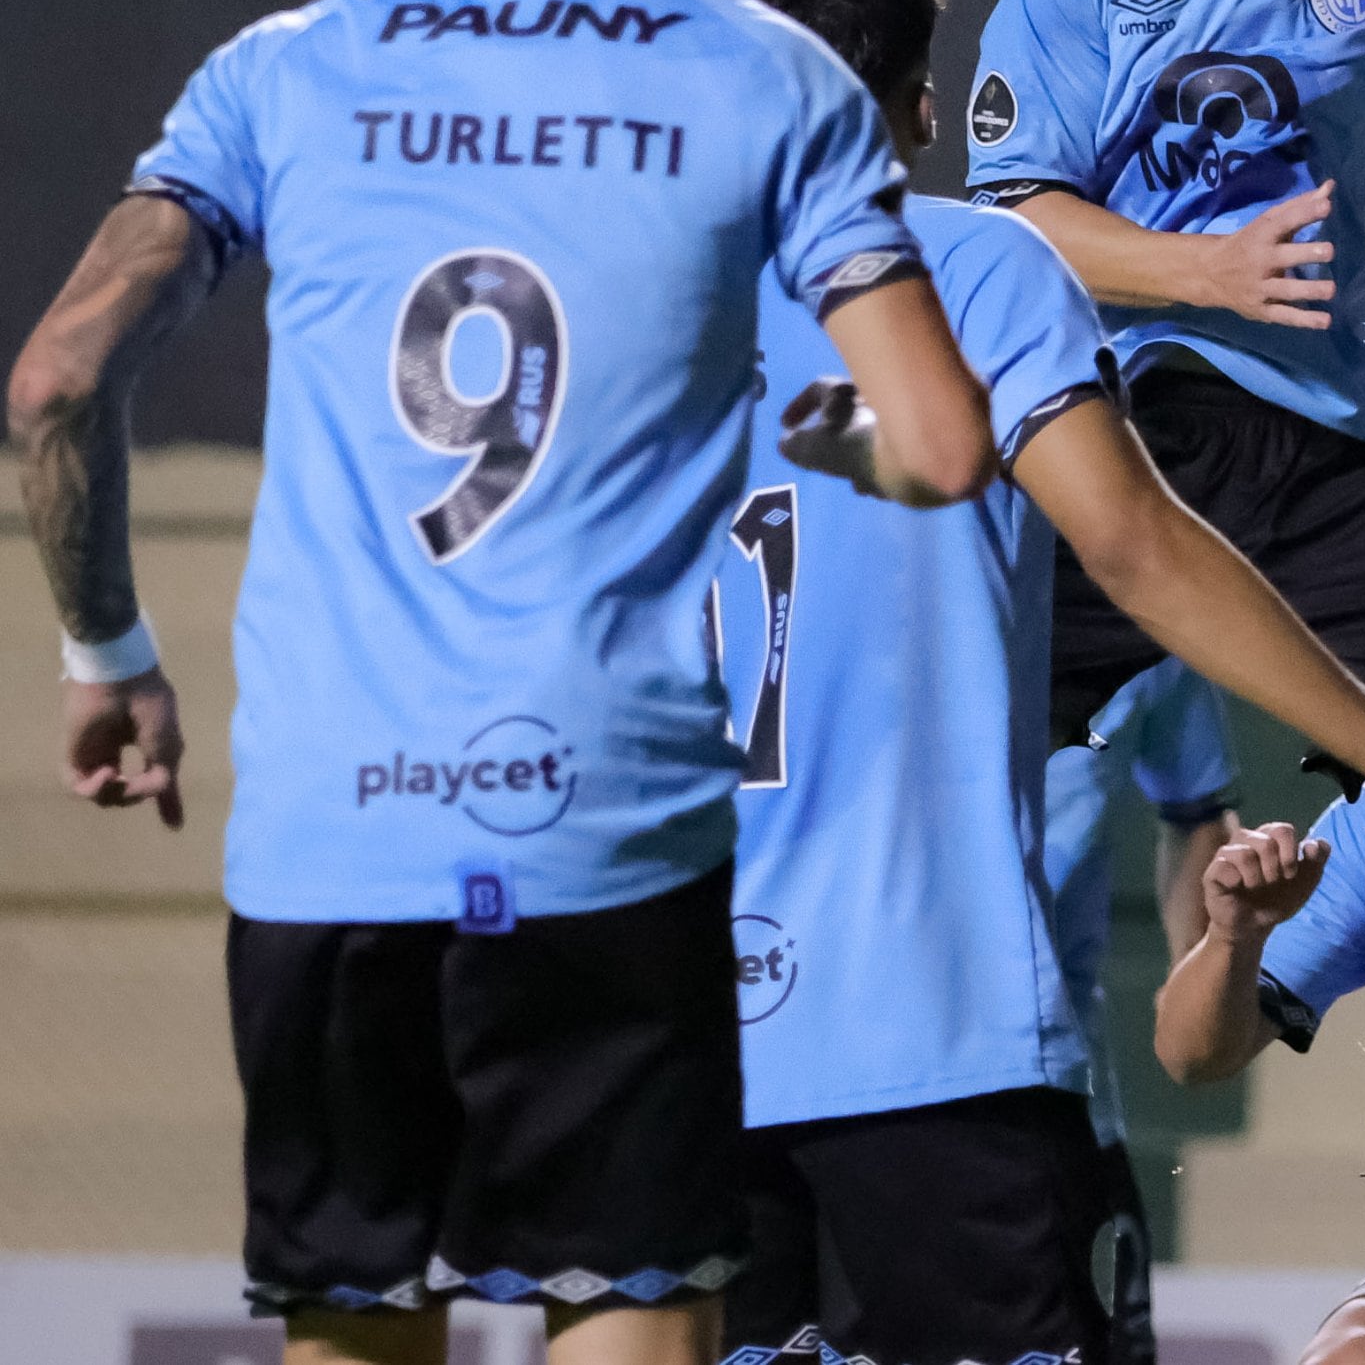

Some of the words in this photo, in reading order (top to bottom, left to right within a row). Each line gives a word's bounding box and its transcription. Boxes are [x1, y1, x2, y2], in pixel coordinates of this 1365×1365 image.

[379, 0, 692, 44] PAUNY
[1119, 18, 1176, 36] umbro
[353, 110, 685, 177] TURLETTI
[387, 246, 570, 566] 9
[357, 749, 561, 809] playcet
